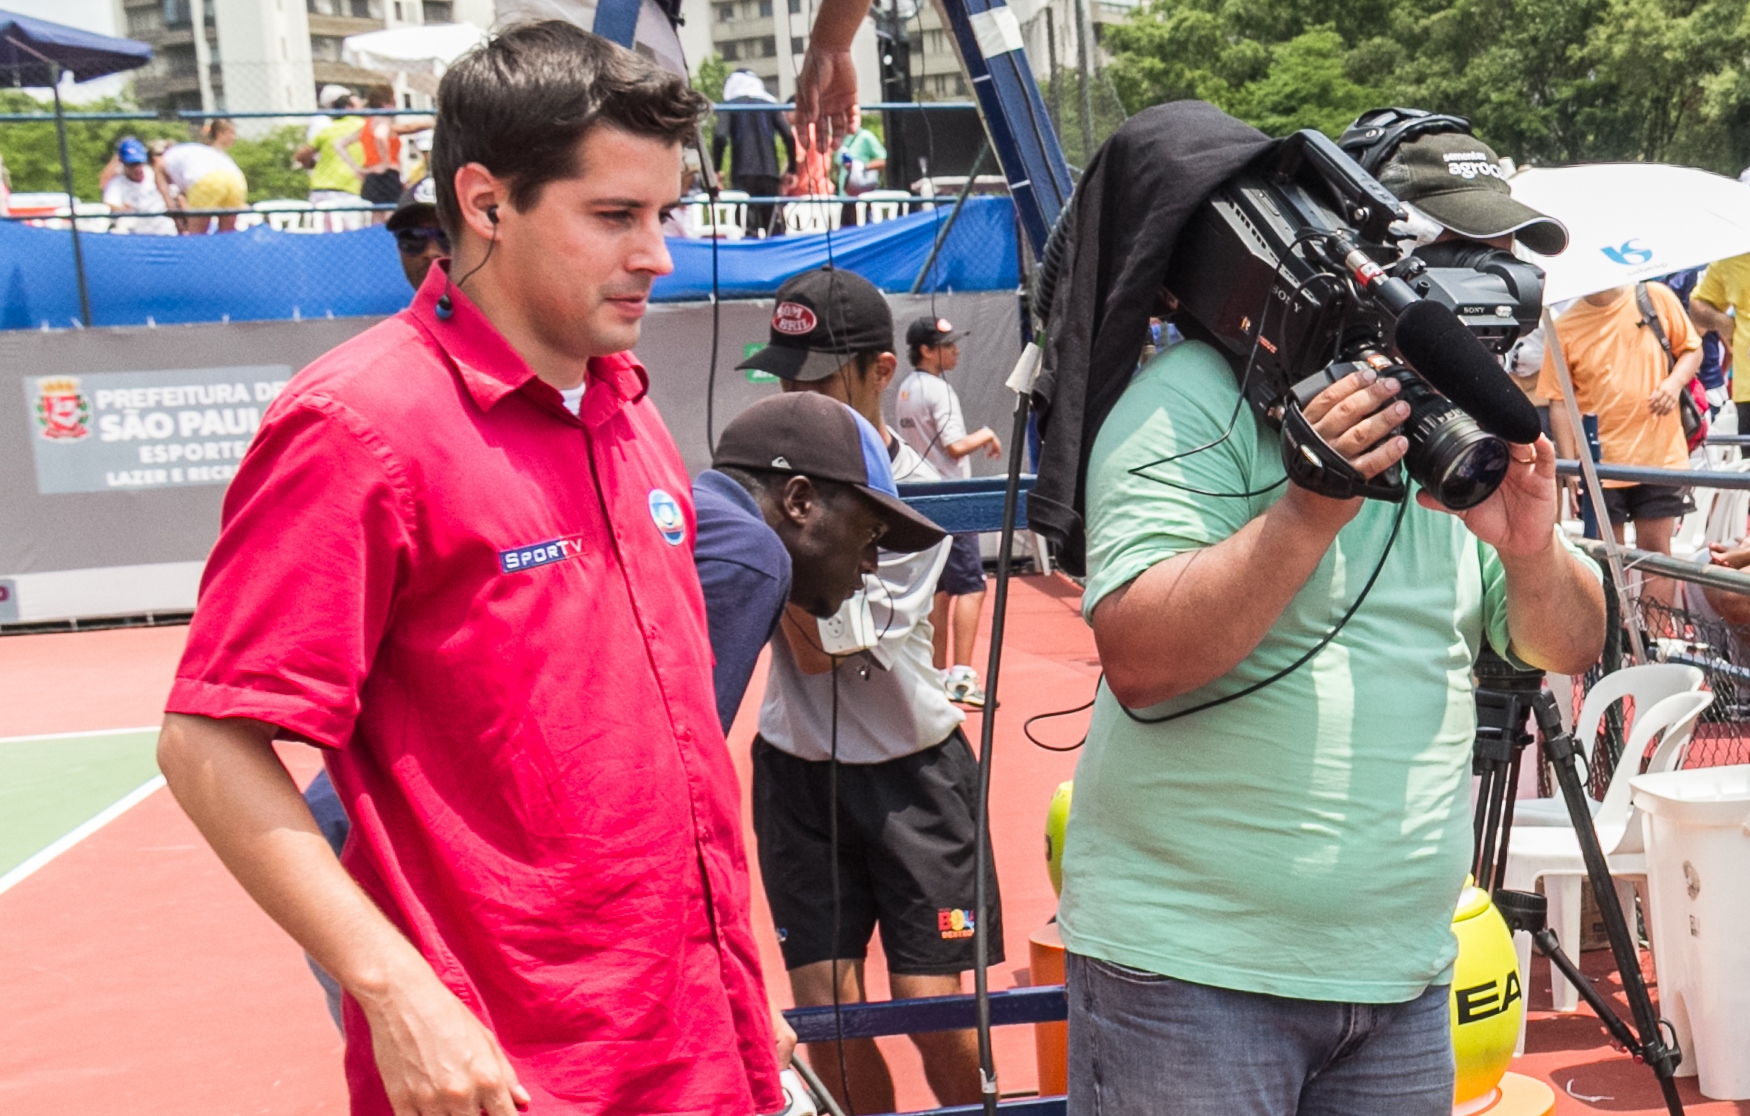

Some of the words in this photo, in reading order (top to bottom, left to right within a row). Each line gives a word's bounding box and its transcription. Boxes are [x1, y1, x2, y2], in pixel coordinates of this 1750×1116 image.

[1463, 306, 1485, 314] SONY
[96, 384, 251, 410] PREFEITURA
[100, 408, 174, 442] SÃO
[106, 470, 168, 487] LAZER
[172, 468, 184, 483] E
